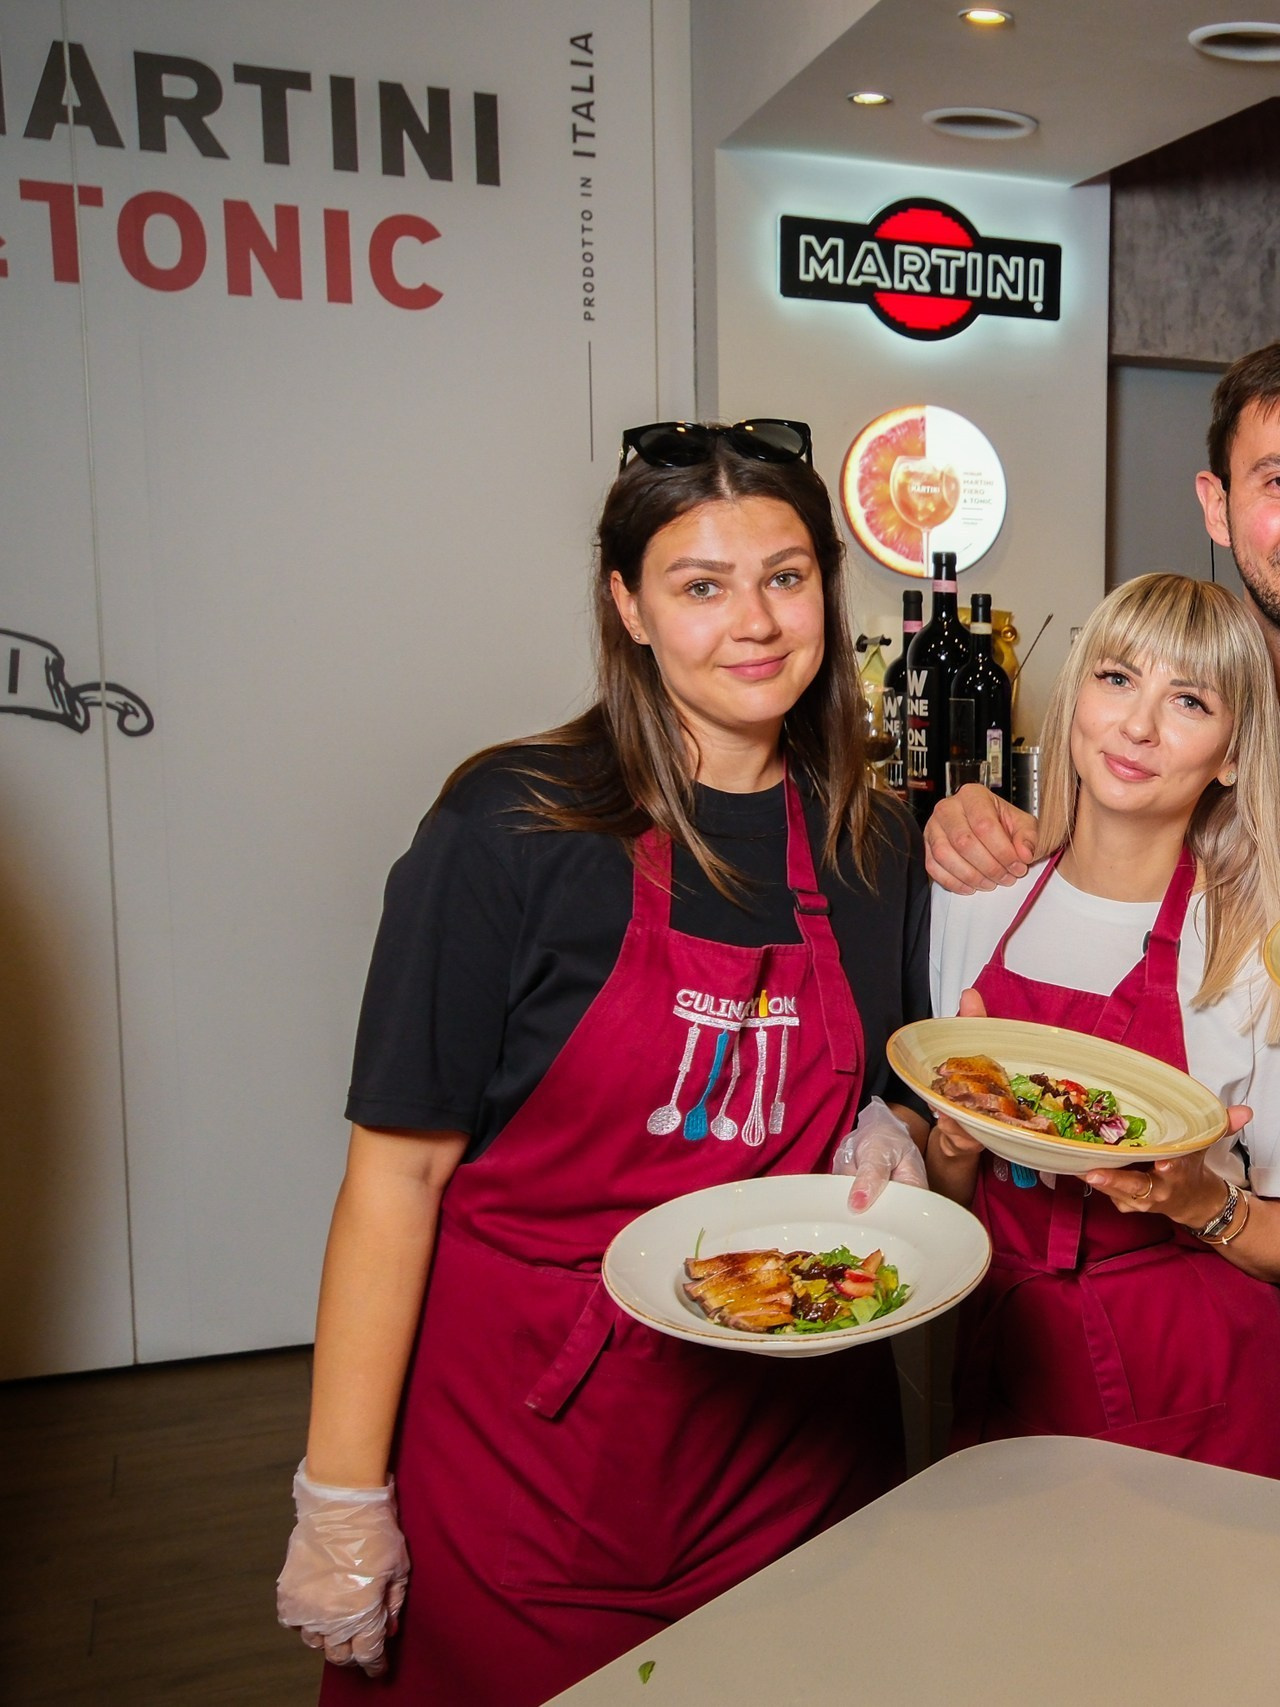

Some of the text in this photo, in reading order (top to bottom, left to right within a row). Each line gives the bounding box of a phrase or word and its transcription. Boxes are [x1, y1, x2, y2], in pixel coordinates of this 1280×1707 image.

[0, 40, 501, 187] ARTINI
[570, 32, 596, 322] PRODOTTO IN ITALIA
[0, 178, 444, 311] TONIC
